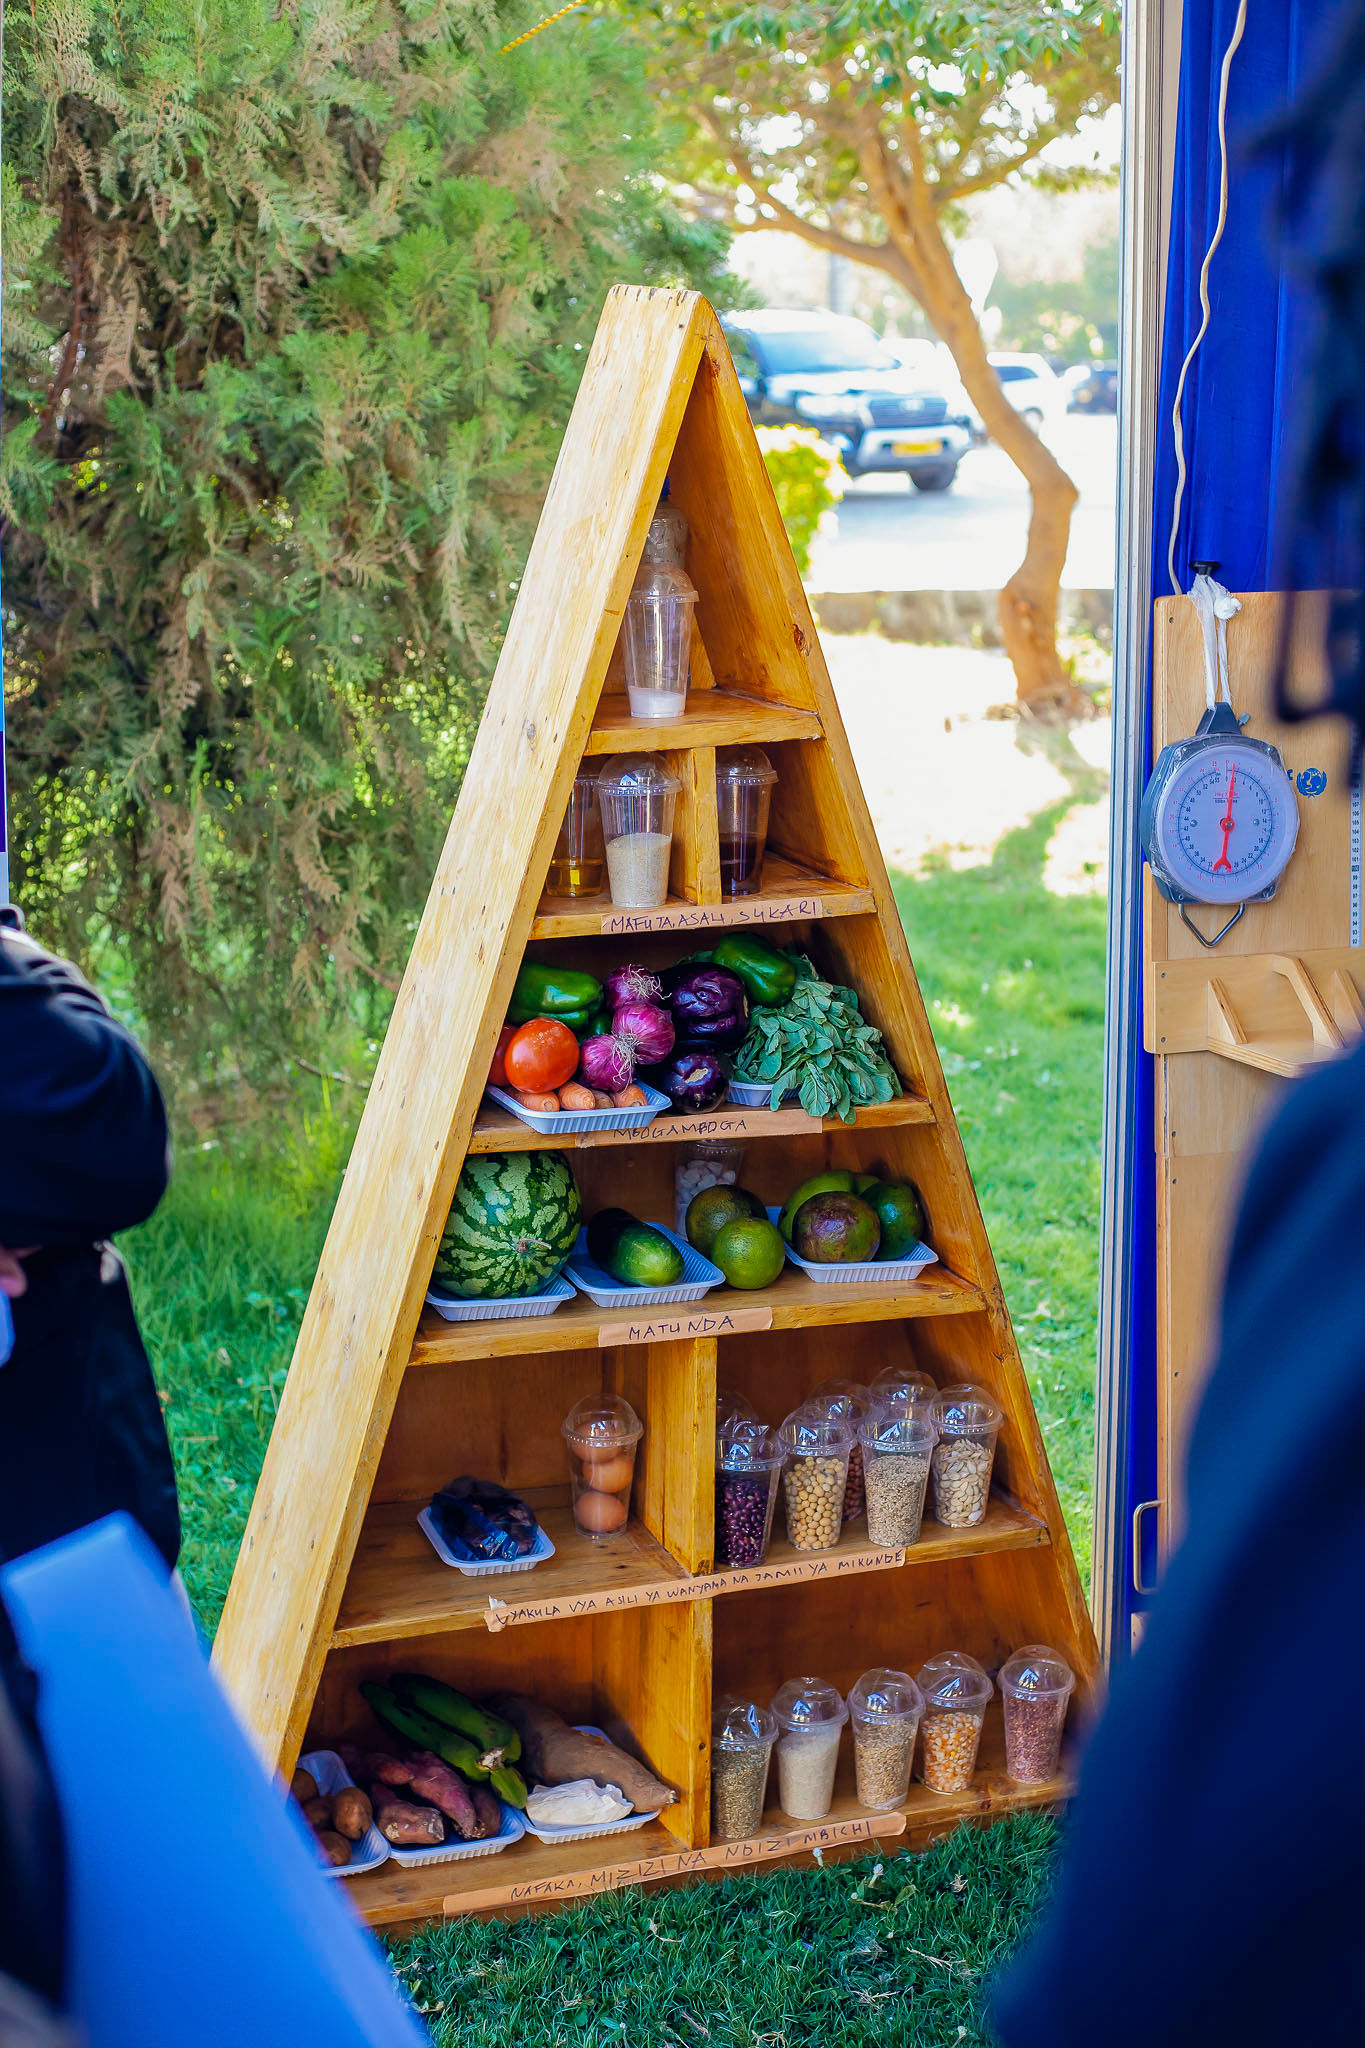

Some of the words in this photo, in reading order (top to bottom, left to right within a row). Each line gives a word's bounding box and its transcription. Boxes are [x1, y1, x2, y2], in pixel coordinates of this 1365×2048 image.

[609, 914, 676, 933] MAFUTA,
[738, 900, 817, 923] SUKARI
[628, 1315, 735, 1341] MATUNDA
[495, 1605, 561, 1625] VYAKULA
[569, 1599, 597, 1614] VYA
[605, 1594, 638, 1606] ASILI
[645, 1590, 660, 1602] YA
[667, 1577, 727, 1598] WANYAMA
[733, 1574, 749, 1585] NA
[755, 1567, 803, 1582] JAMII
[808, 1562, 828, 1577] YA
[838, 1548, 904, 1570] MIKUNDE
[510, 1878, 582, 1901] NAFAKA,
[590, 1858, 667, 1887] MIZIZI
[677, 1851, 707, 1872] NA
[725, 1837, 791, 1861] NDIZI
[803, 1820, 872, 1845] MBICHI
